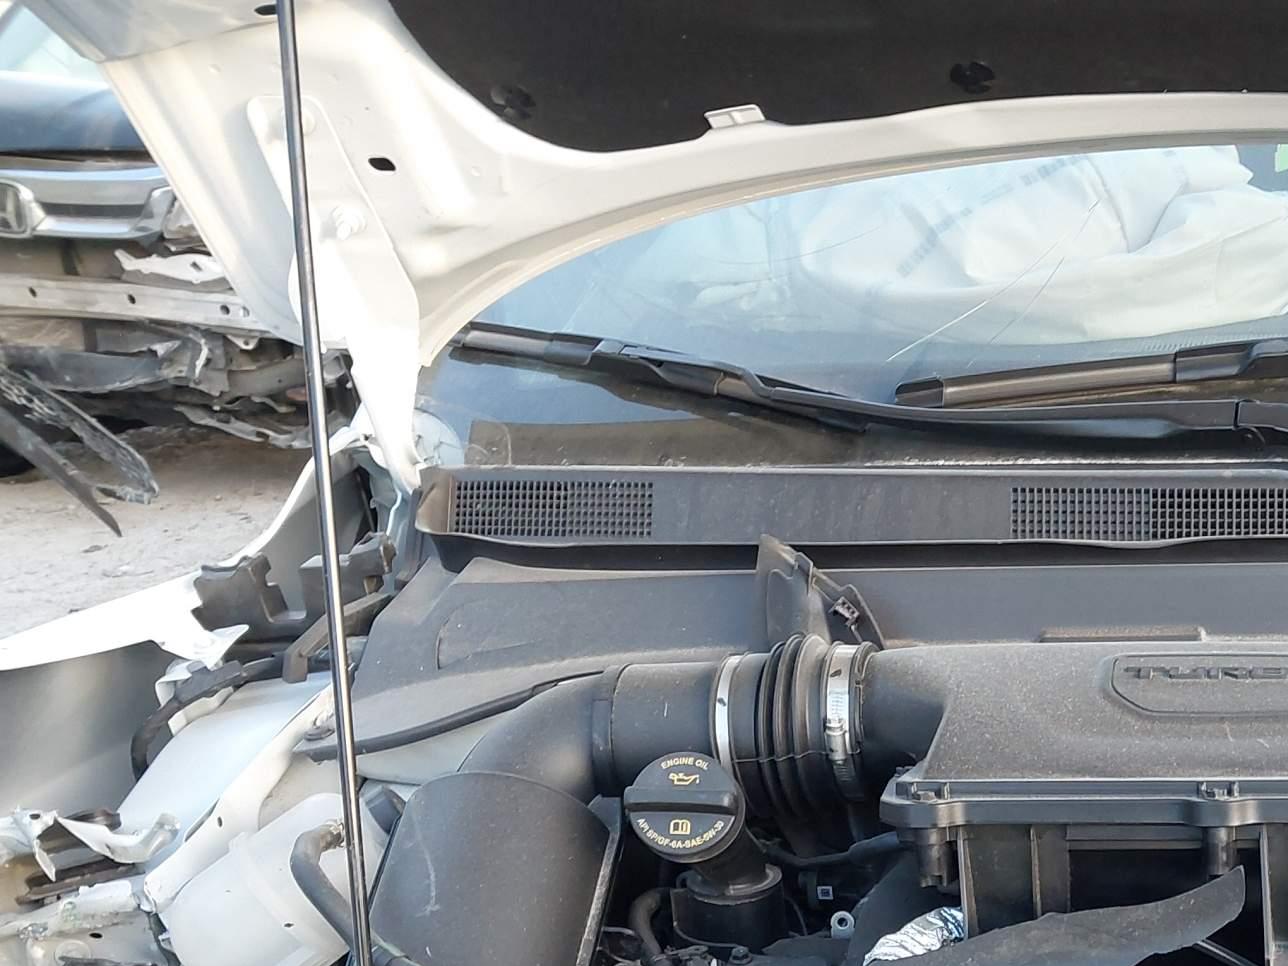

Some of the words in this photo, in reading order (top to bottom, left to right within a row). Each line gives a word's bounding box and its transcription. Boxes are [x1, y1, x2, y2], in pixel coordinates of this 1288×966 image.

[661, 757, 694, 769] ENGINE
[695, 759, 710, 770] OIL
[637, 818, 649, 833] API
